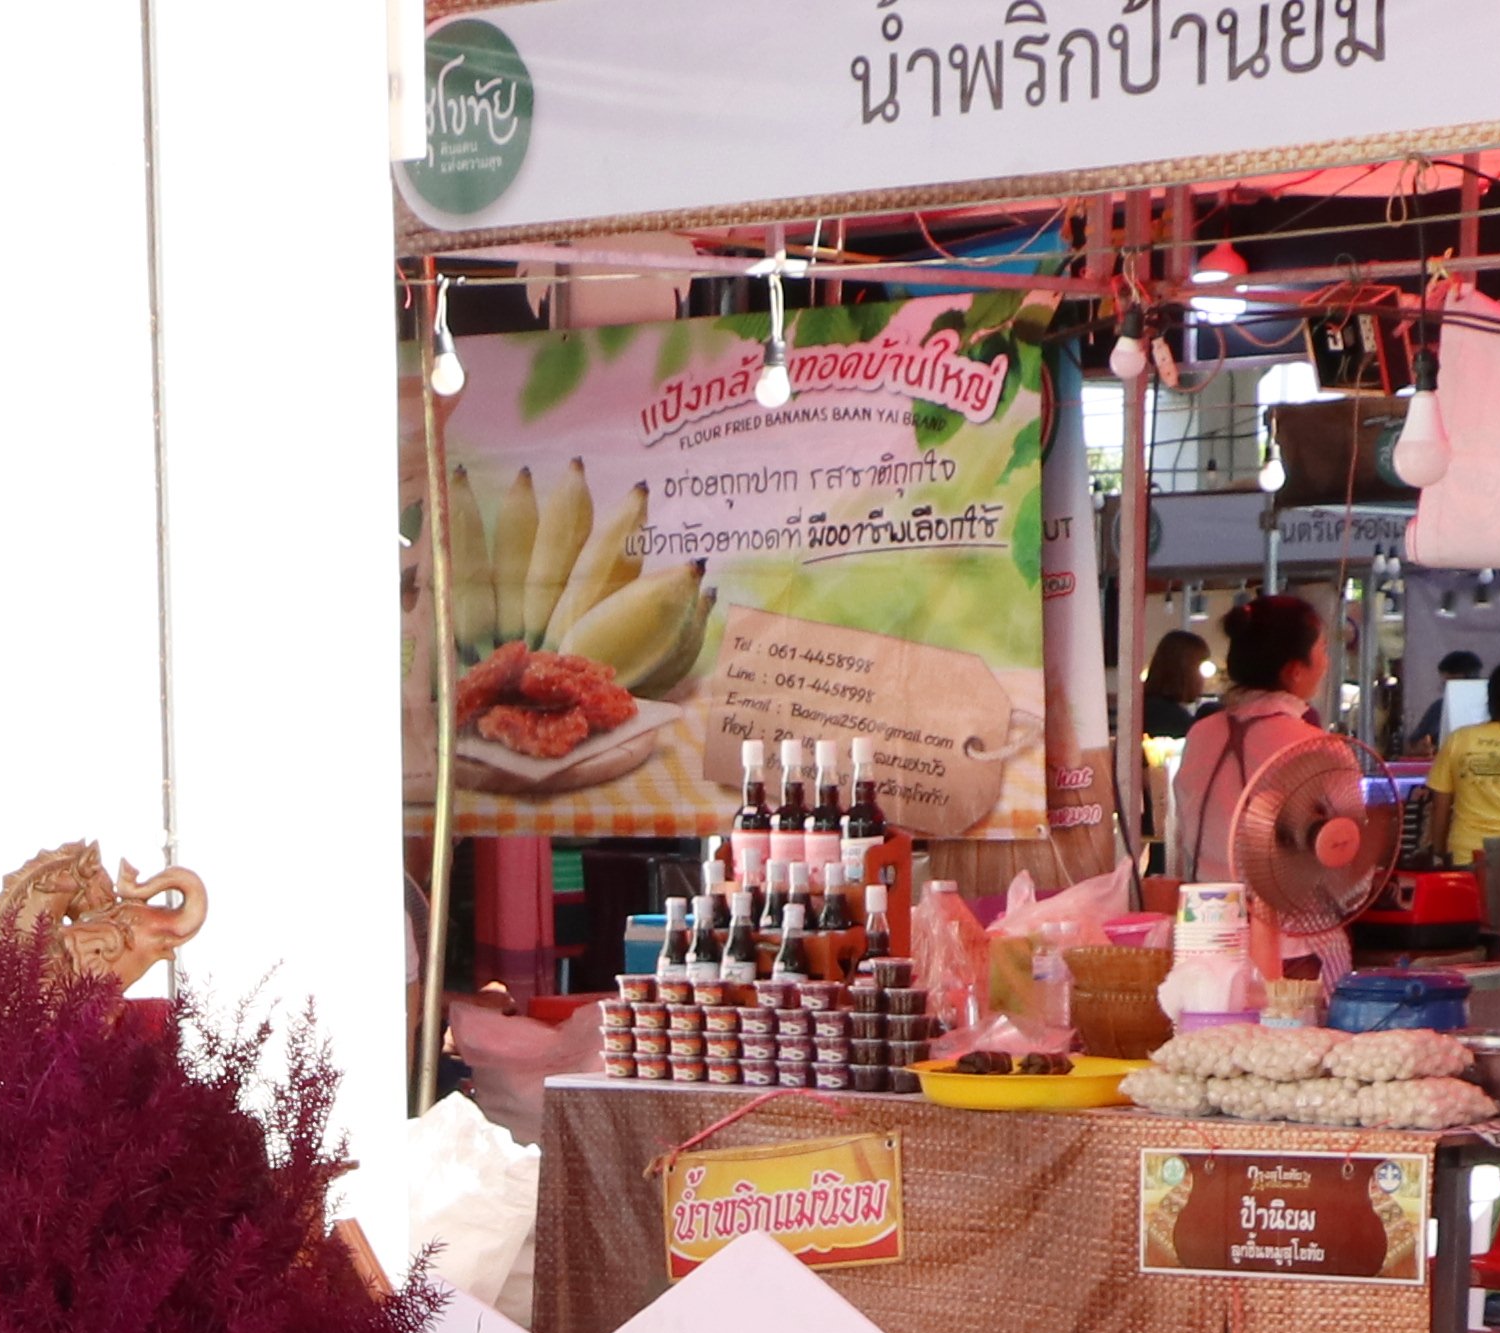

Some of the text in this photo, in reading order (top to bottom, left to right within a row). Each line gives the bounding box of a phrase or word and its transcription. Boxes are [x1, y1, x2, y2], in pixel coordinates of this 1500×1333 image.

[640, 335, 1001, 435] แป้งกล้ทอดบ้านใหญ่
[679, 407, 947, 451] FLOUR FRIED BANANAS BAAN YAI BRAND
[664, 449, 957, 510] อร่อยถูกปาก รสชาติถูกใจ
[734, 636, 752, 652] Tel
[727, 664, 755, 681] Line
[673, 1168, 888, 1243] น้ำพริกแม่นิยม
[1239, 1195, 1317, 1232] ป้านิยม
